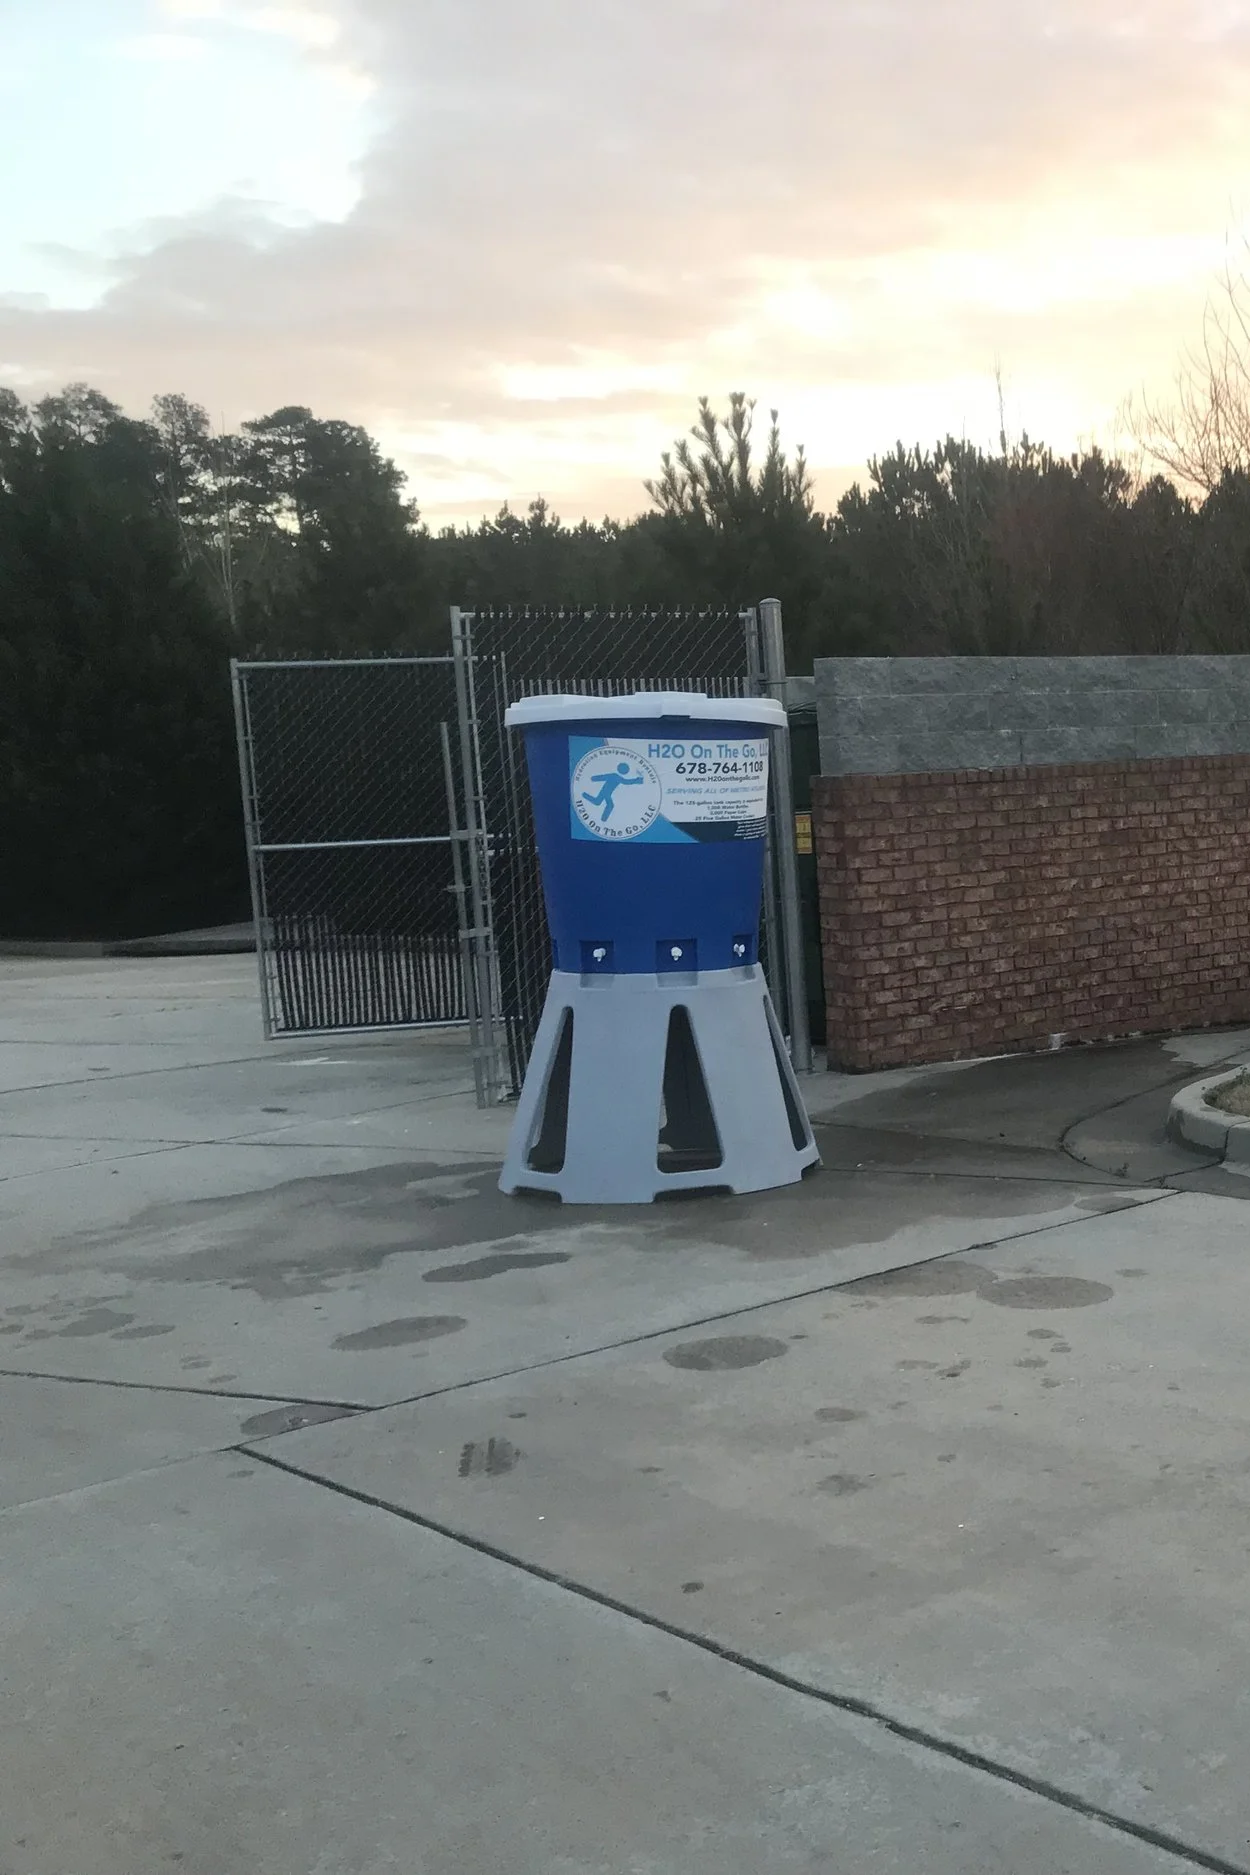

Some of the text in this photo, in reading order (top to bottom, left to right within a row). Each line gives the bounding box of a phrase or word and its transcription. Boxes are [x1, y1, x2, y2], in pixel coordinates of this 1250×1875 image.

[648, 744, 685, 759] H2O
[690, 744, 713, 759] On
[716, 743, 739, 759] The
[675, 761, 763, 775] 678-764-1108
[666, 787, 703, 795] SERVING
[589, 820, 601, 833] On
[603, 827, 623, 837] The
[641, 804, 656, 824] LLC
